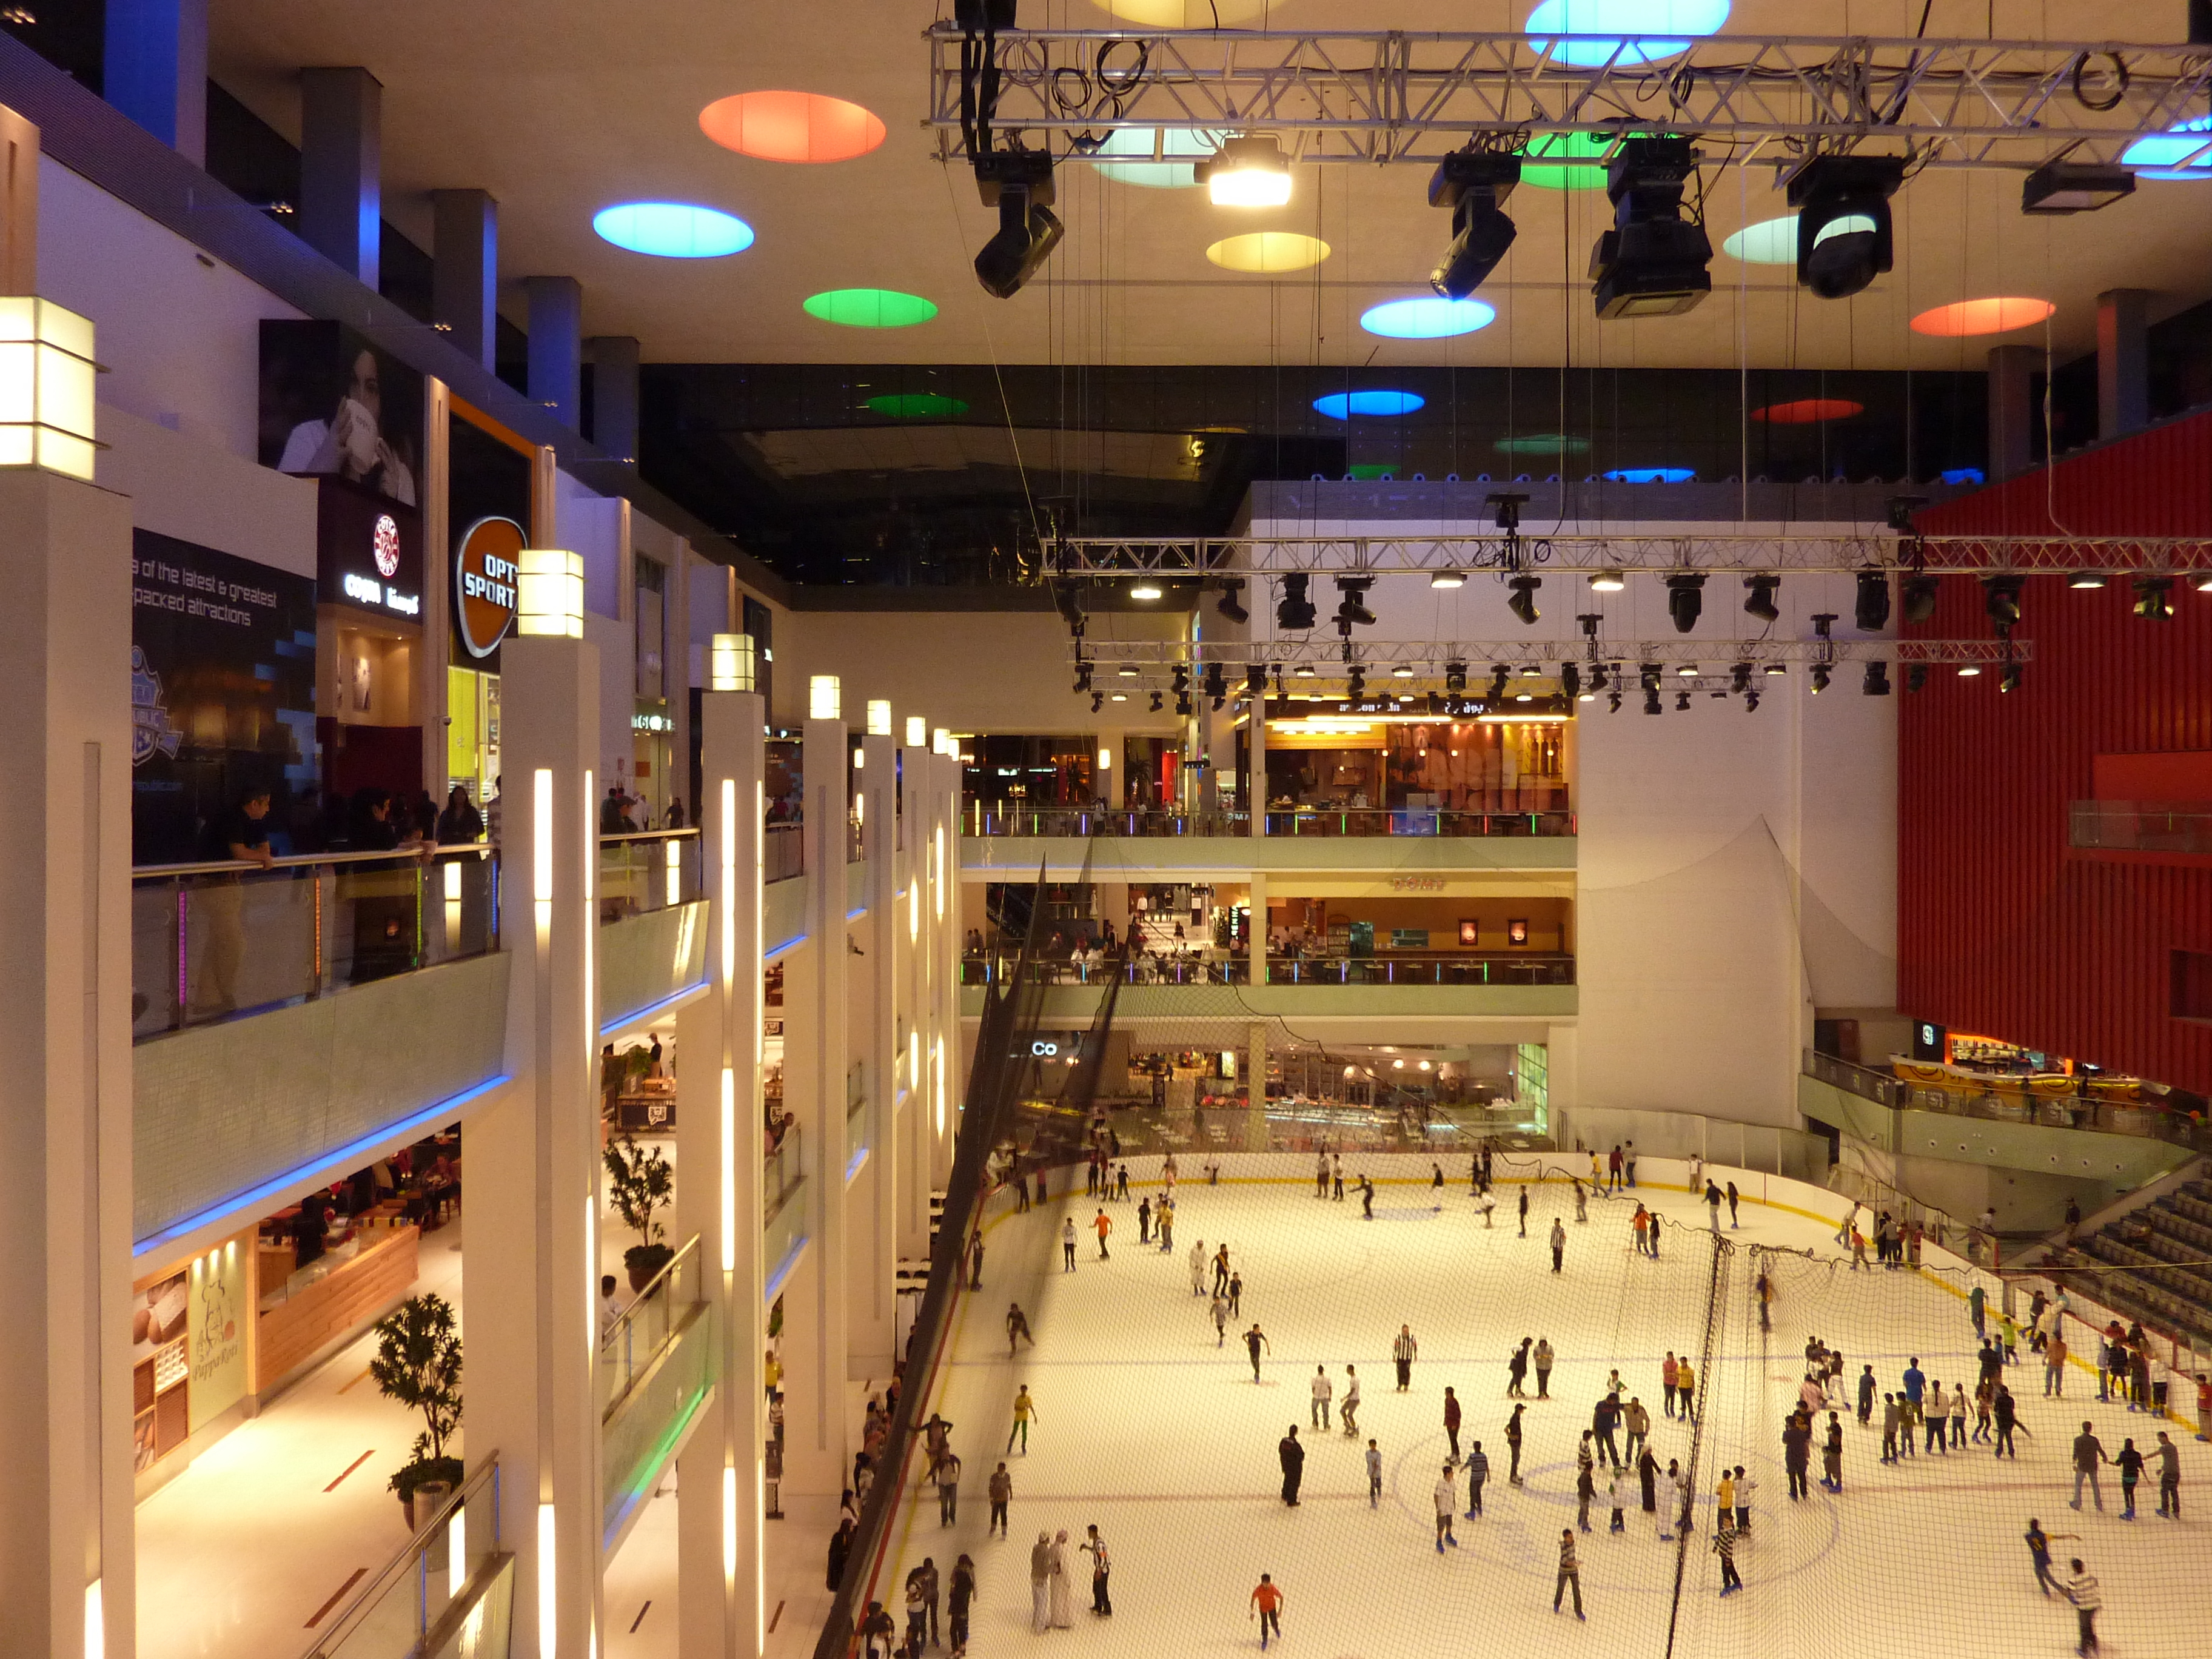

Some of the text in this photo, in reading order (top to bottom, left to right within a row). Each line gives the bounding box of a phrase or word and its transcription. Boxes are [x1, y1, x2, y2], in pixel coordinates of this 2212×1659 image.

[142, 560, 155, 578] of
[158, 561, 179, 583] the
[183, 568, 216, 593] latest
[218, 581, 227, 595] &
[230, 584, 277, 608] greatest
[465, 572, 515, 609] SPORT
[188, 598, 251, 626] attractions
